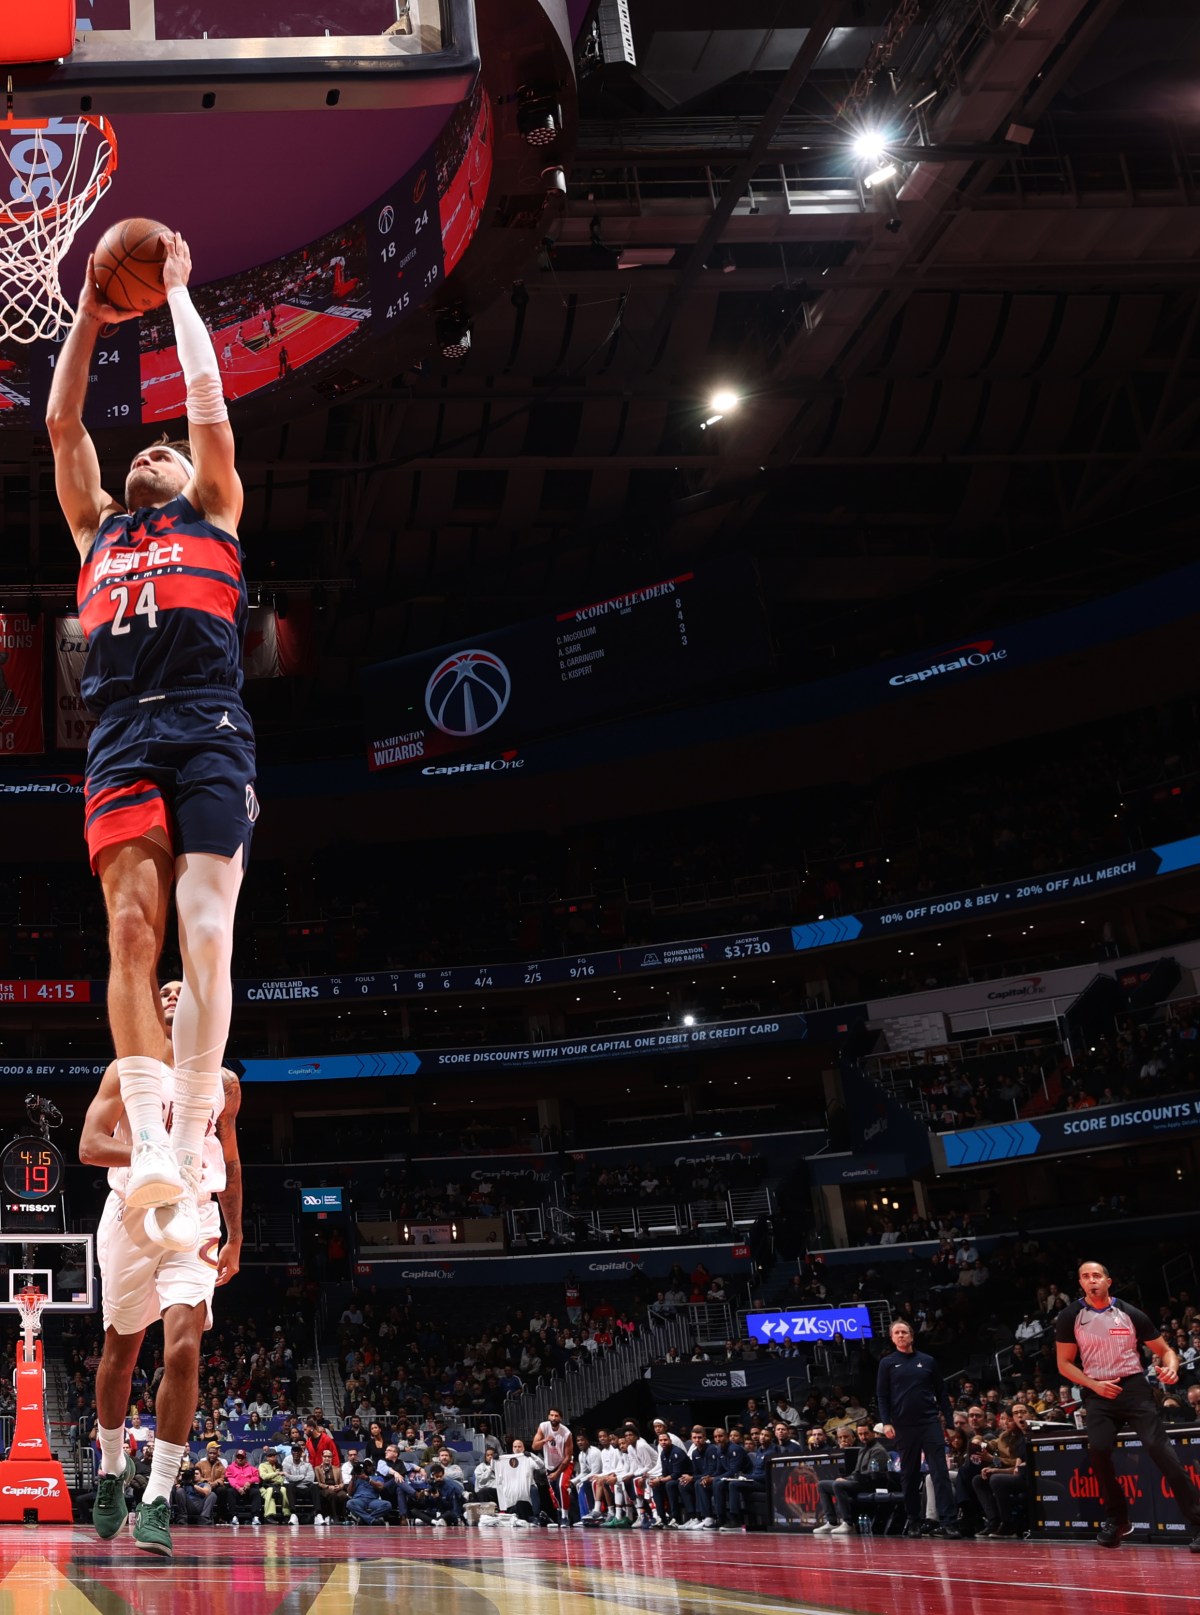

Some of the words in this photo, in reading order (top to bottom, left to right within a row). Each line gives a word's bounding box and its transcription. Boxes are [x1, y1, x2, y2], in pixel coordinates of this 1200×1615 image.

[414, 209, 429, 235] 24
[380, 241, 397, 263] 18
[399, 247, 417, 269] QUARTER
[423, 264, 438, 288] :19
[385, 292, 410, 319] 4:15
[97, 351, 120, 365] 24
[106, 404, 130, 418] :19
[94, 541, 184, 582] district
[110, 581, 159, 636] 24
[575, 597, 623, 623] SCORING
[624, 580, 676, 607] LEADERS
[675, 598, 681, 608] 8
[565, 643, 581, 656] SARR
[677, 610, 684, 620] 4
[566, 648, 604, 668] CARRINGTON
[680, 623, 686, 633] 3
[568, 664, 592, 680] KISPERT
[681, 635, 687, 646] 3
[372, 729, 425, 750] WASHINGTON
[374, 741, 425, 767] WIZARDS
[879, 912, 903, 925] 10%
[905, 906, 928, 920] OFF
[929, 901, 962, 917] FOOD
[964, 898, 974, 908] &
[976, 892, 1000, 907] BEV
[1016, 884, 1043, 899] 20%
[1045, 878, 1070, 893] OFF
[1072, 872, 1094, 887] ALL
[1095, 860, 1137, 882] MERCH
[663, 946, 703, 957] FOUNDATION
[684, 952, 705, 961] RAFFLE
[724, 941, 771, 959] $3,730
[524, 972, 542, 984] 2/5
[569, 965, 595, 978] 9/16
[262, 980, 303, 989] CLEVELAND
[417, 981, 424, 990] 9
[443, 979, 450, 989] 6
[474, 976, 494, 987] 4/4
[37, 984, 75, 999] 4:15
[247, 986, 319, 1000] CAVALIERS
[333, 986, 340, 995] 6
[361, 985, 368, 994] 0
[438, 1053, 471, 1064] SCORE
[473, 1050, 530, 1062] DISCOUNTS
[532, 1046, 558, 1059] WITH
[560, 1043, 588, 1056] YOUR
[590, 1040, 632, 1053] CAPITAL
[634, 1036, 656, 1047] ONE
[658, 1033, 688, 1045] DEBIT
[691, 1031, 706, 1041] OR
[709, 1027, 747, 1039] CREDIT
[750, 1023, 780, 1035] CARD
[26, 1066, 34, 1075] &
[36, 1066, 56, 1075] BEV
[68, 1066, 91, 1075] 20%
[1063, 1116, 1107, 1135] SCORE
[1110, 1102, 1191, 1128] DISCOUNTS
[20, 1151, 51, 1165] 4:15
[24, 1166, 49, 1193] 19
[19, 1204, 57, 1213] TISSOT
[735, 1247, 748, 1257] 104
[356, 1264, 370, 1274] 104
[792, 1316, 858, 1337] ZKsync
[701, 1377, 728, 1388] Globe
